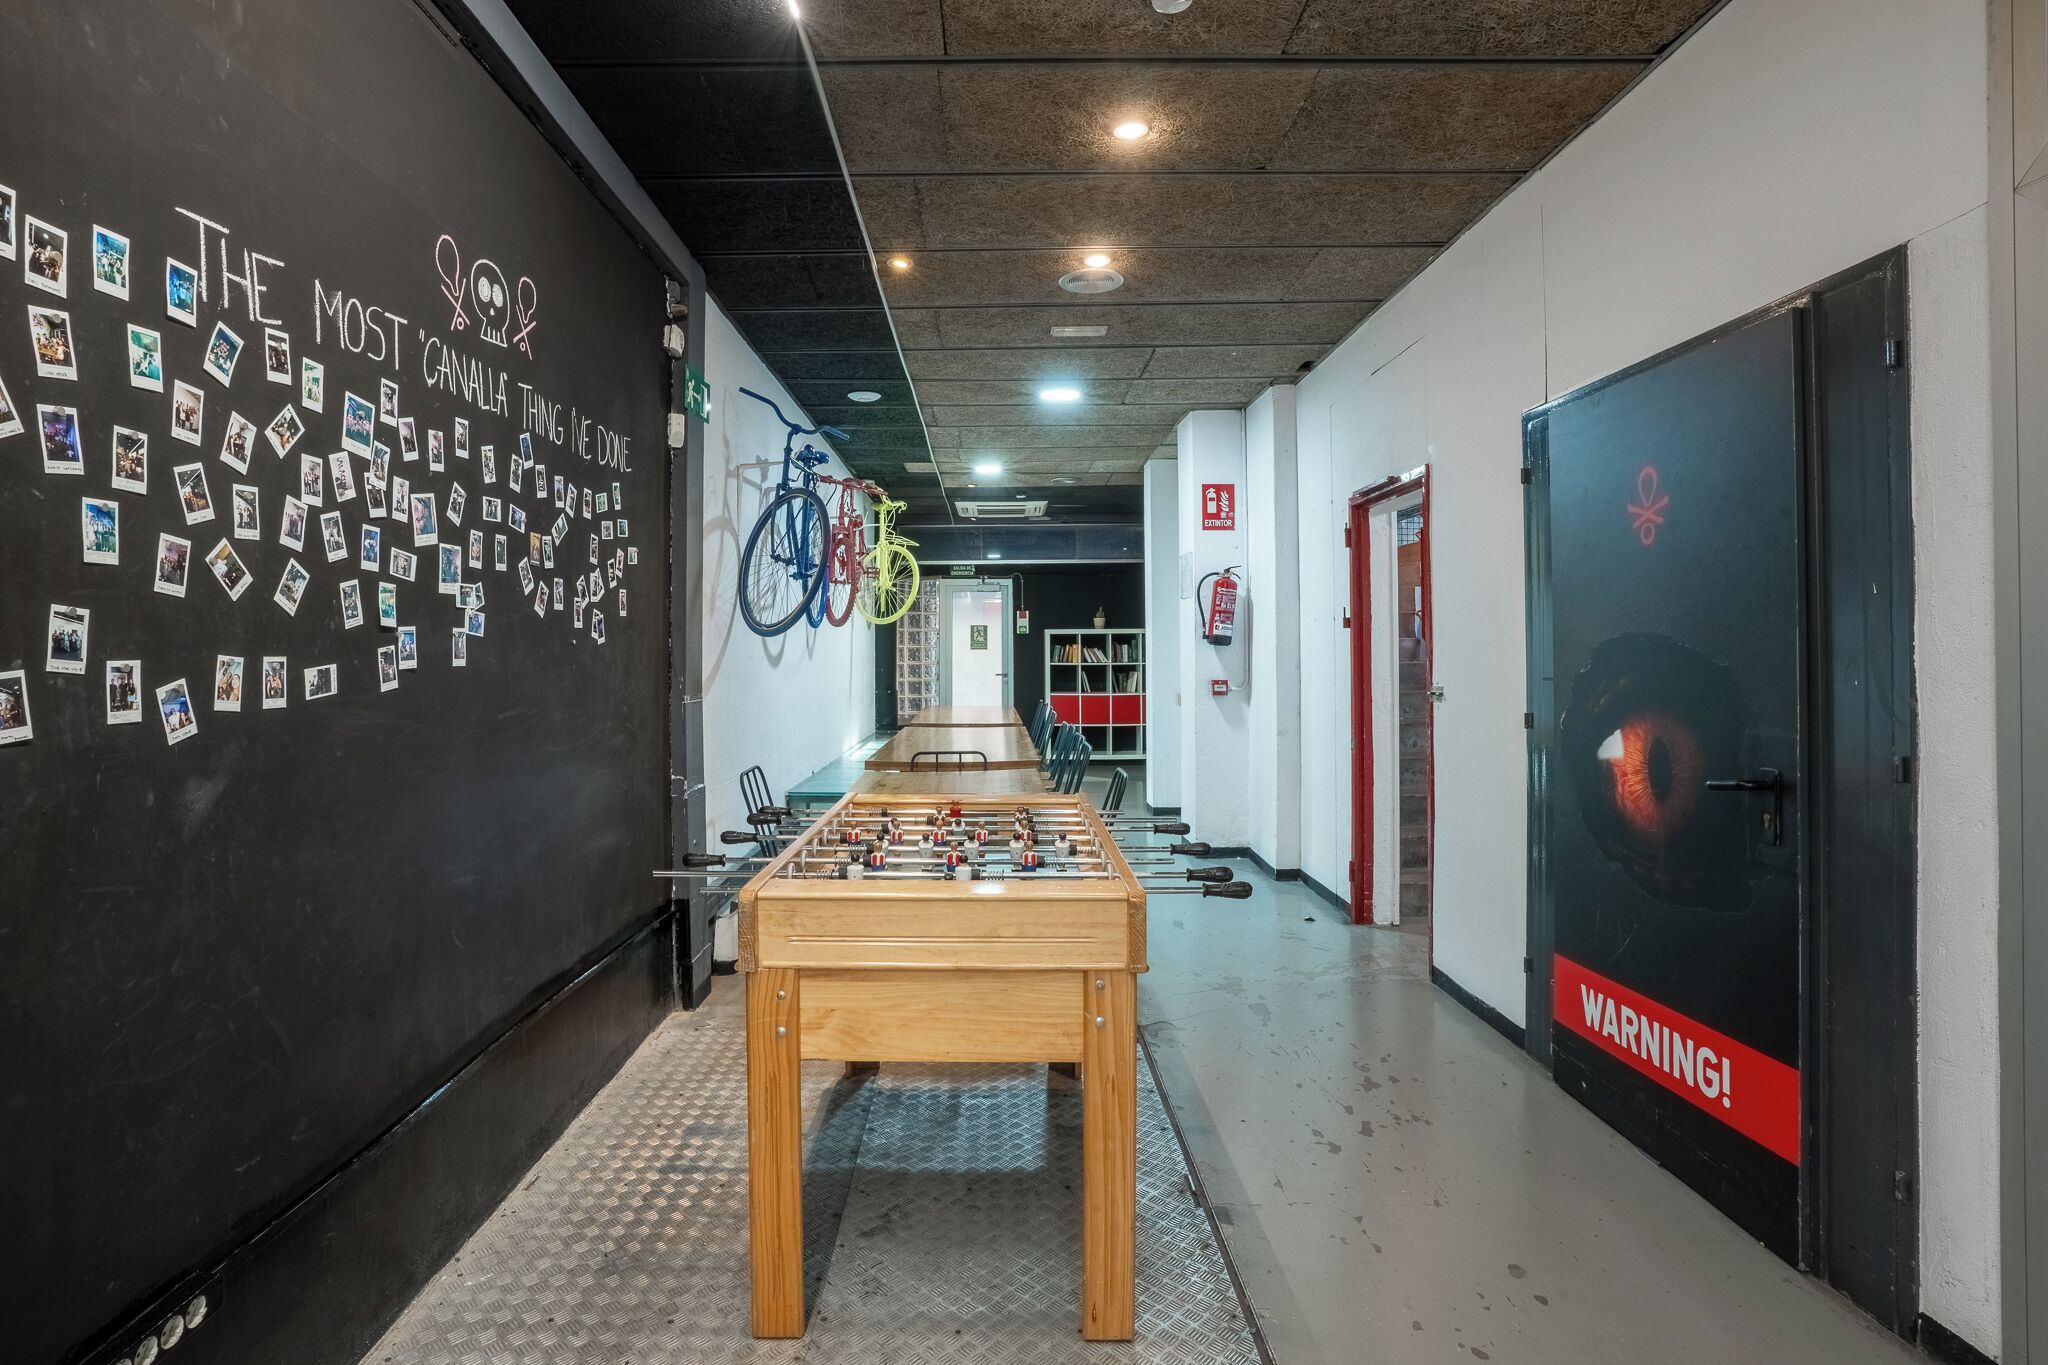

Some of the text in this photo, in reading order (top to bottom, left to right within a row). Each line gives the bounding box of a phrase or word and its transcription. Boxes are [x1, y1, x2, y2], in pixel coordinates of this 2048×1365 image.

[174, 206, 285, 326] THE
[314, 277, 408, 371] MOST
[517, 382, 564, 445] THING
[571, 408, 592, 460] I'VE
[597, 425, 633, 473] DONE
[1204, 519, 1233, 527] EXTINTOR
[1580, 983, 1731, 1109] WARNING!
